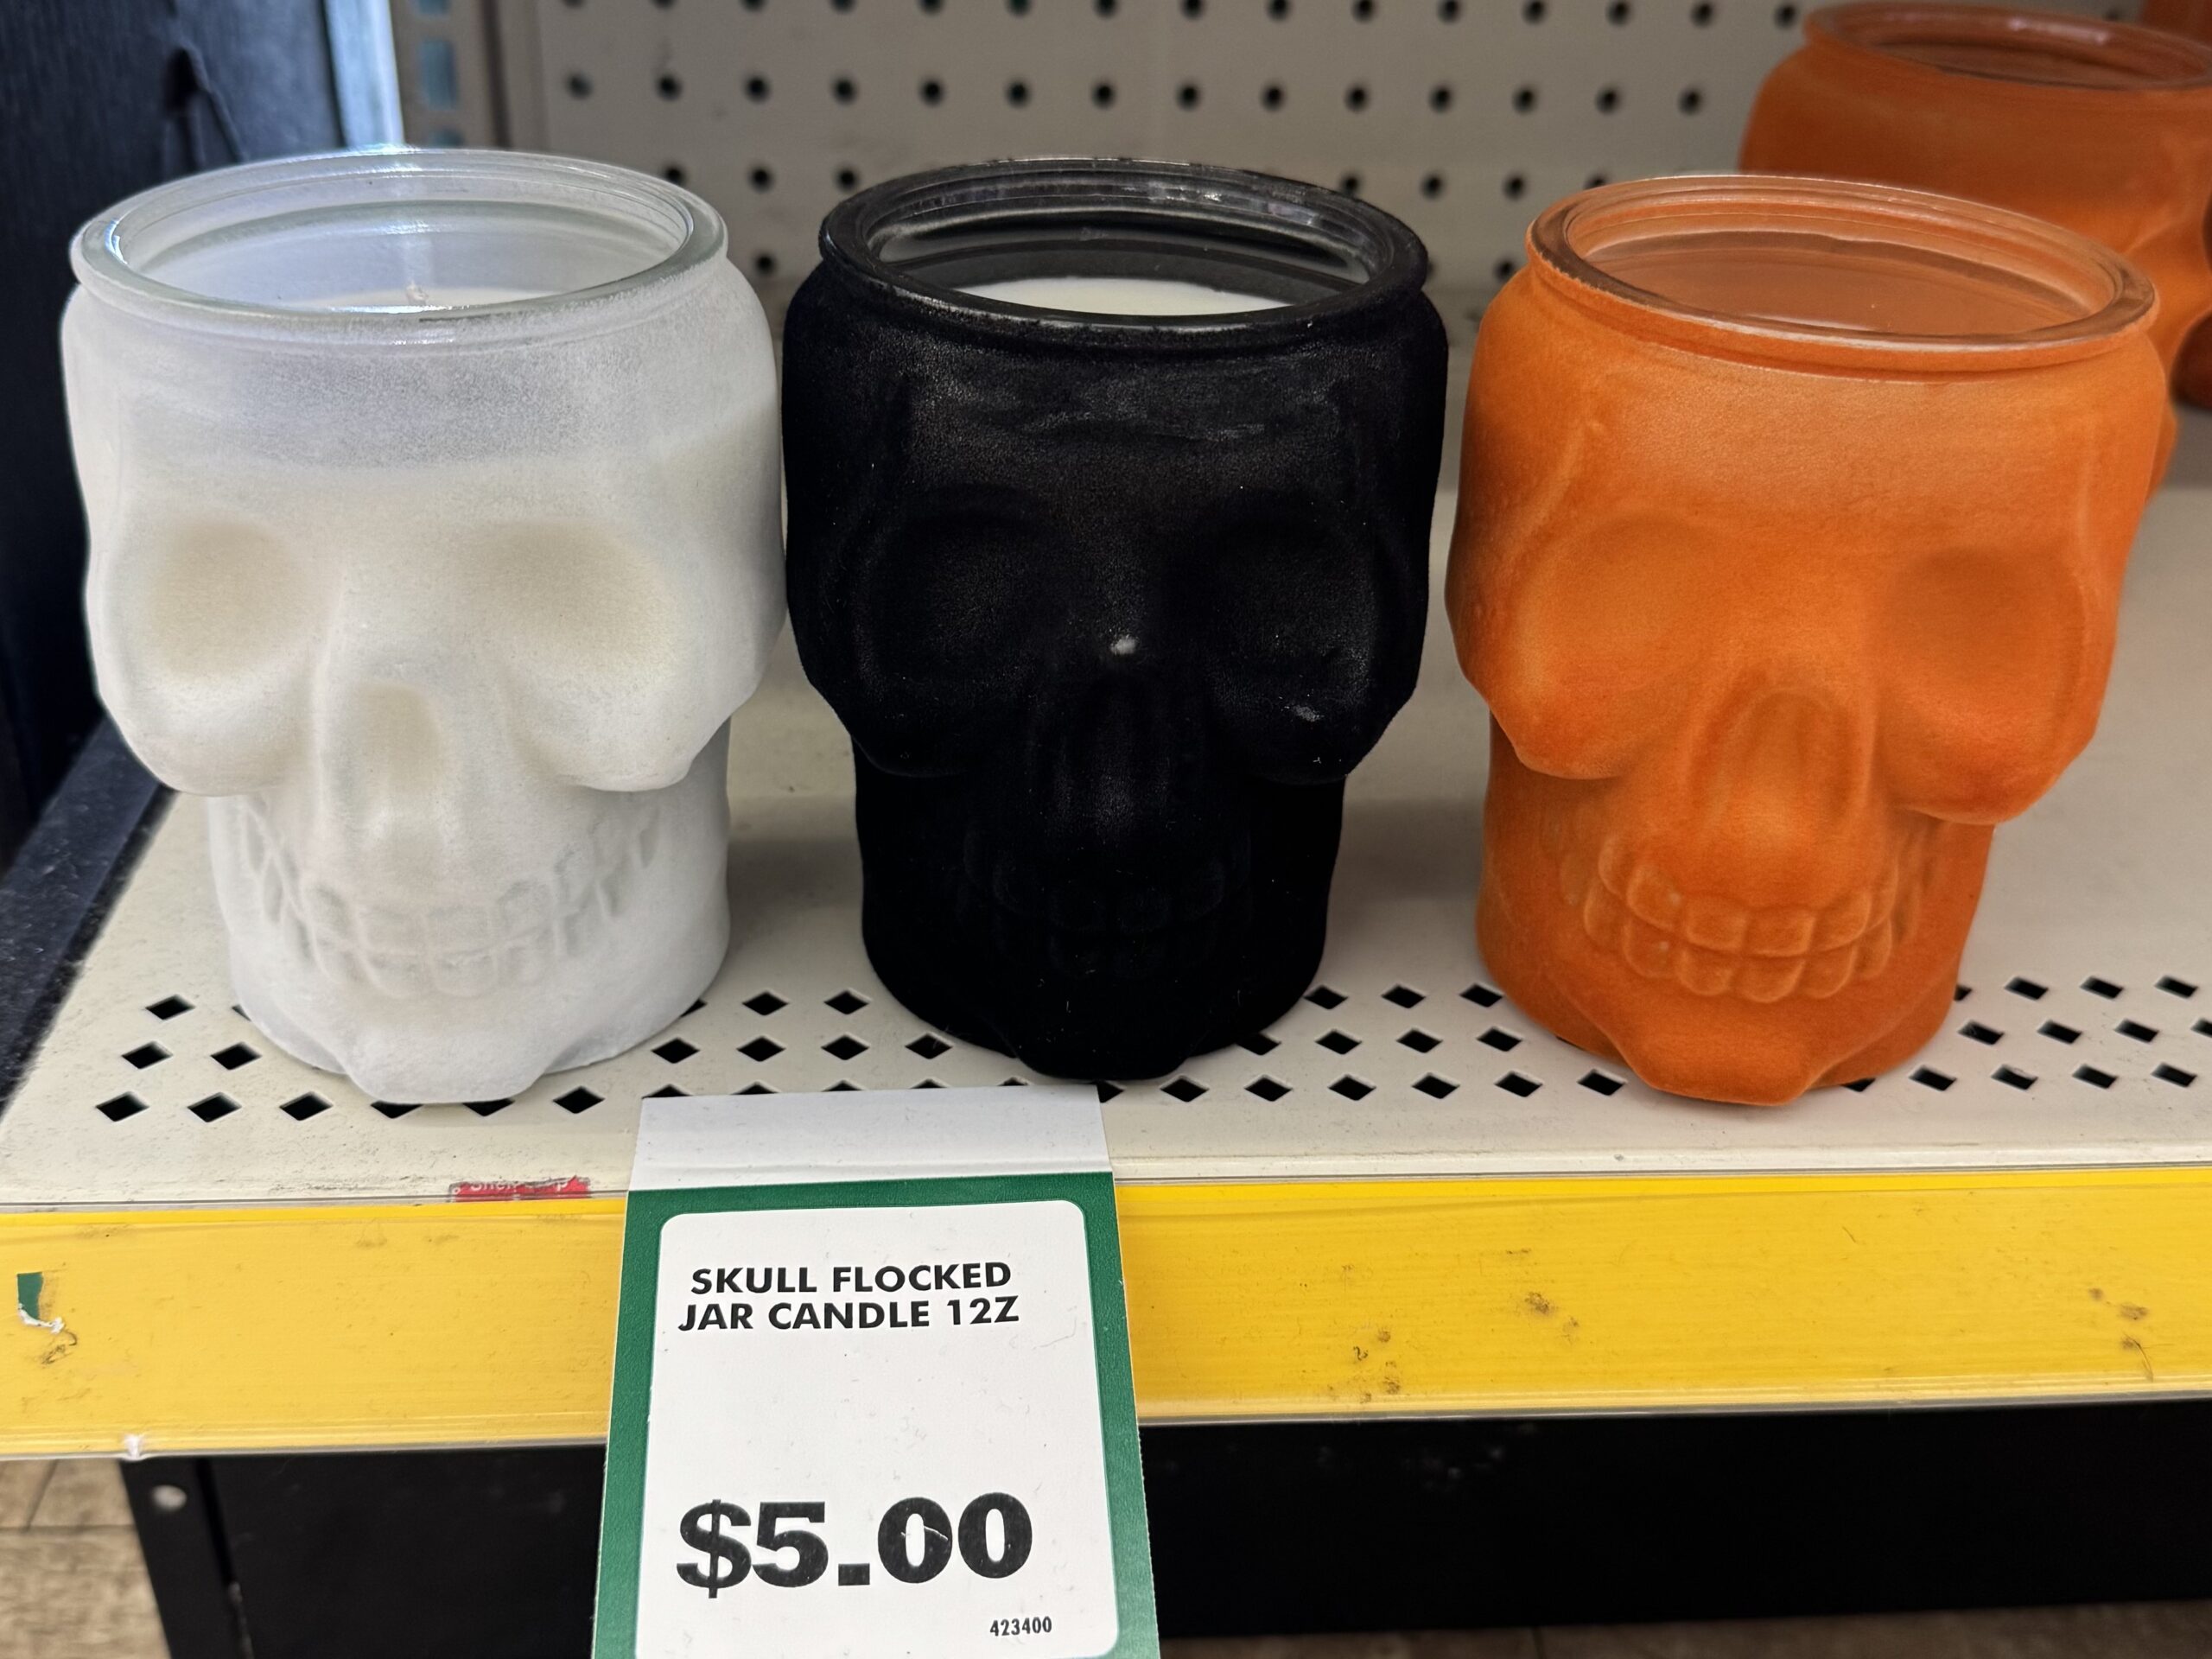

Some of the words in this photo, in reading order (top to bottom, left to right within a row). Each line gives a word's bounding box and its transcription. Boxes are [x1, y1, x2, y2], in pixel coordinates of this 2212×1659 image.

[690, 1267, 818, 1295] SKULL
[832, 1262, 1012, 1293] FLOCKED
[677, 1302, 754, 1332] JAR
[767, 1300, 931, 1330] CANDLE
[946, 1295, 1020, 1325] 12Z
[676, 1492, 1033, 1599] $5.00
[989, 1616, 1053, 1637] 423400
